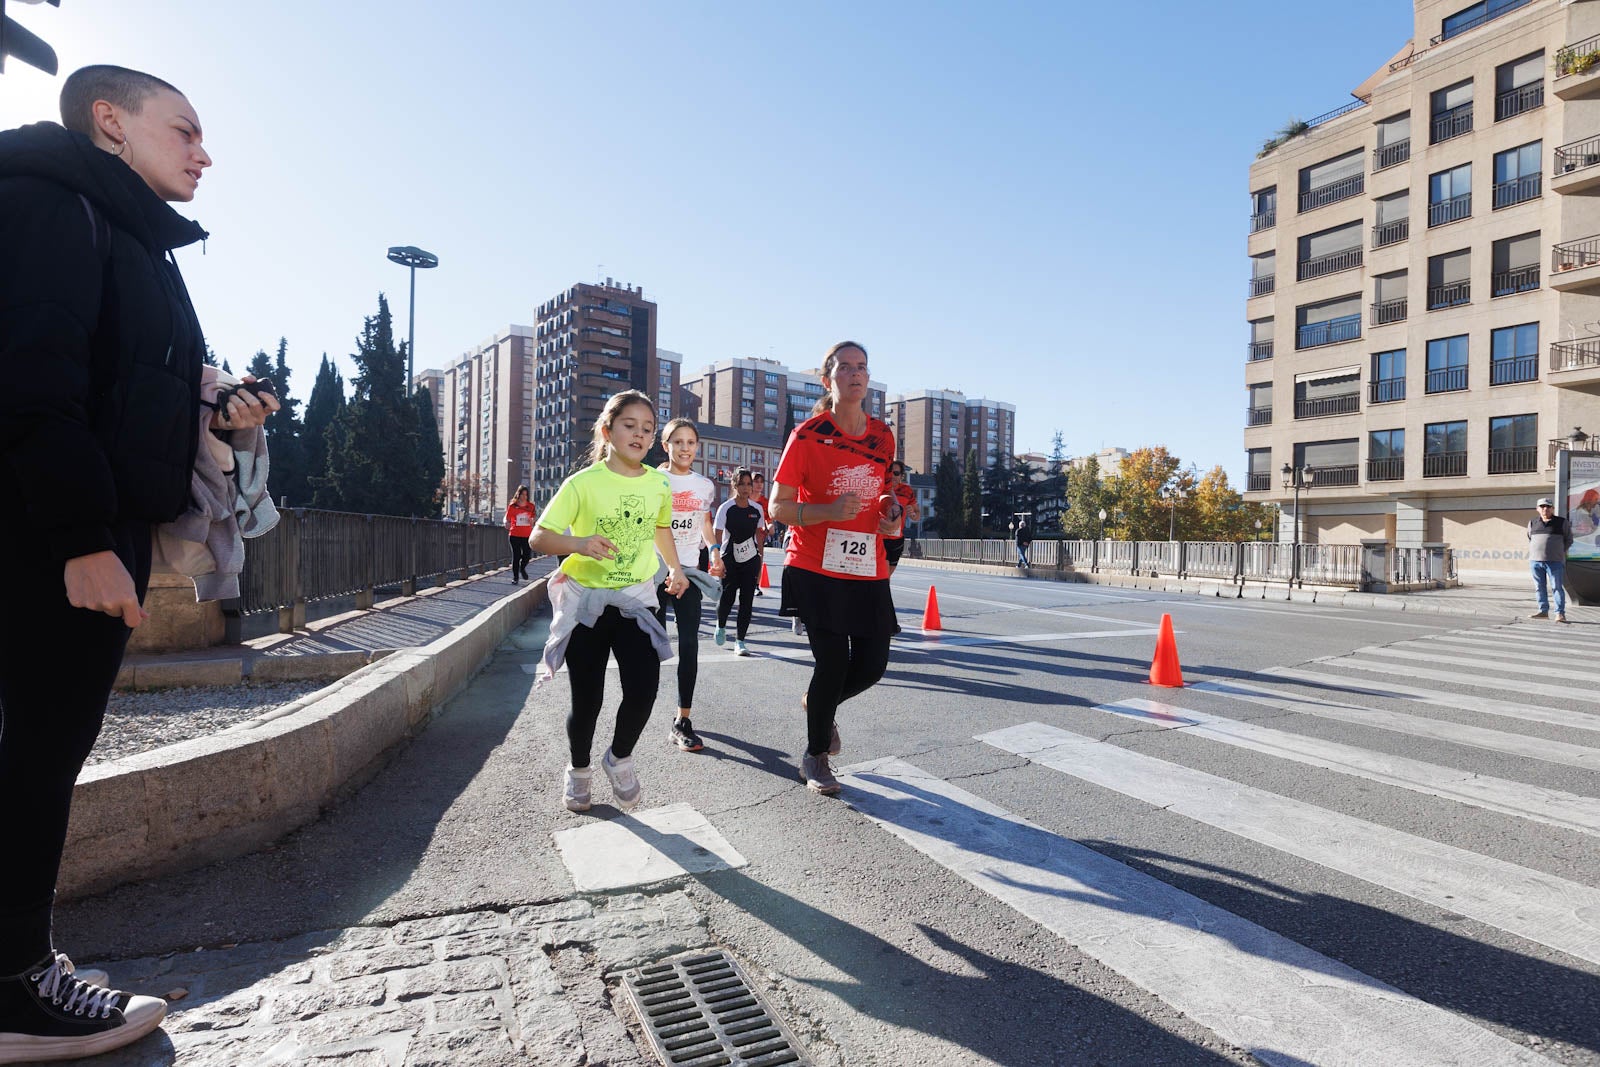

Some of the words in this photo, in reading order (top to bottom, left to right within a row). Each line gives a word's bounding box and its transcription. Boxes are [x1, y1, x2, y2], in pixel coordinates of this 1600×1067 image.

[833, 477, 880, 487] carrera
[671, 519, 693, 530] 648
[840, 540, 867, 555] 128
[1454, 549, 1530, 560] ERCADON
